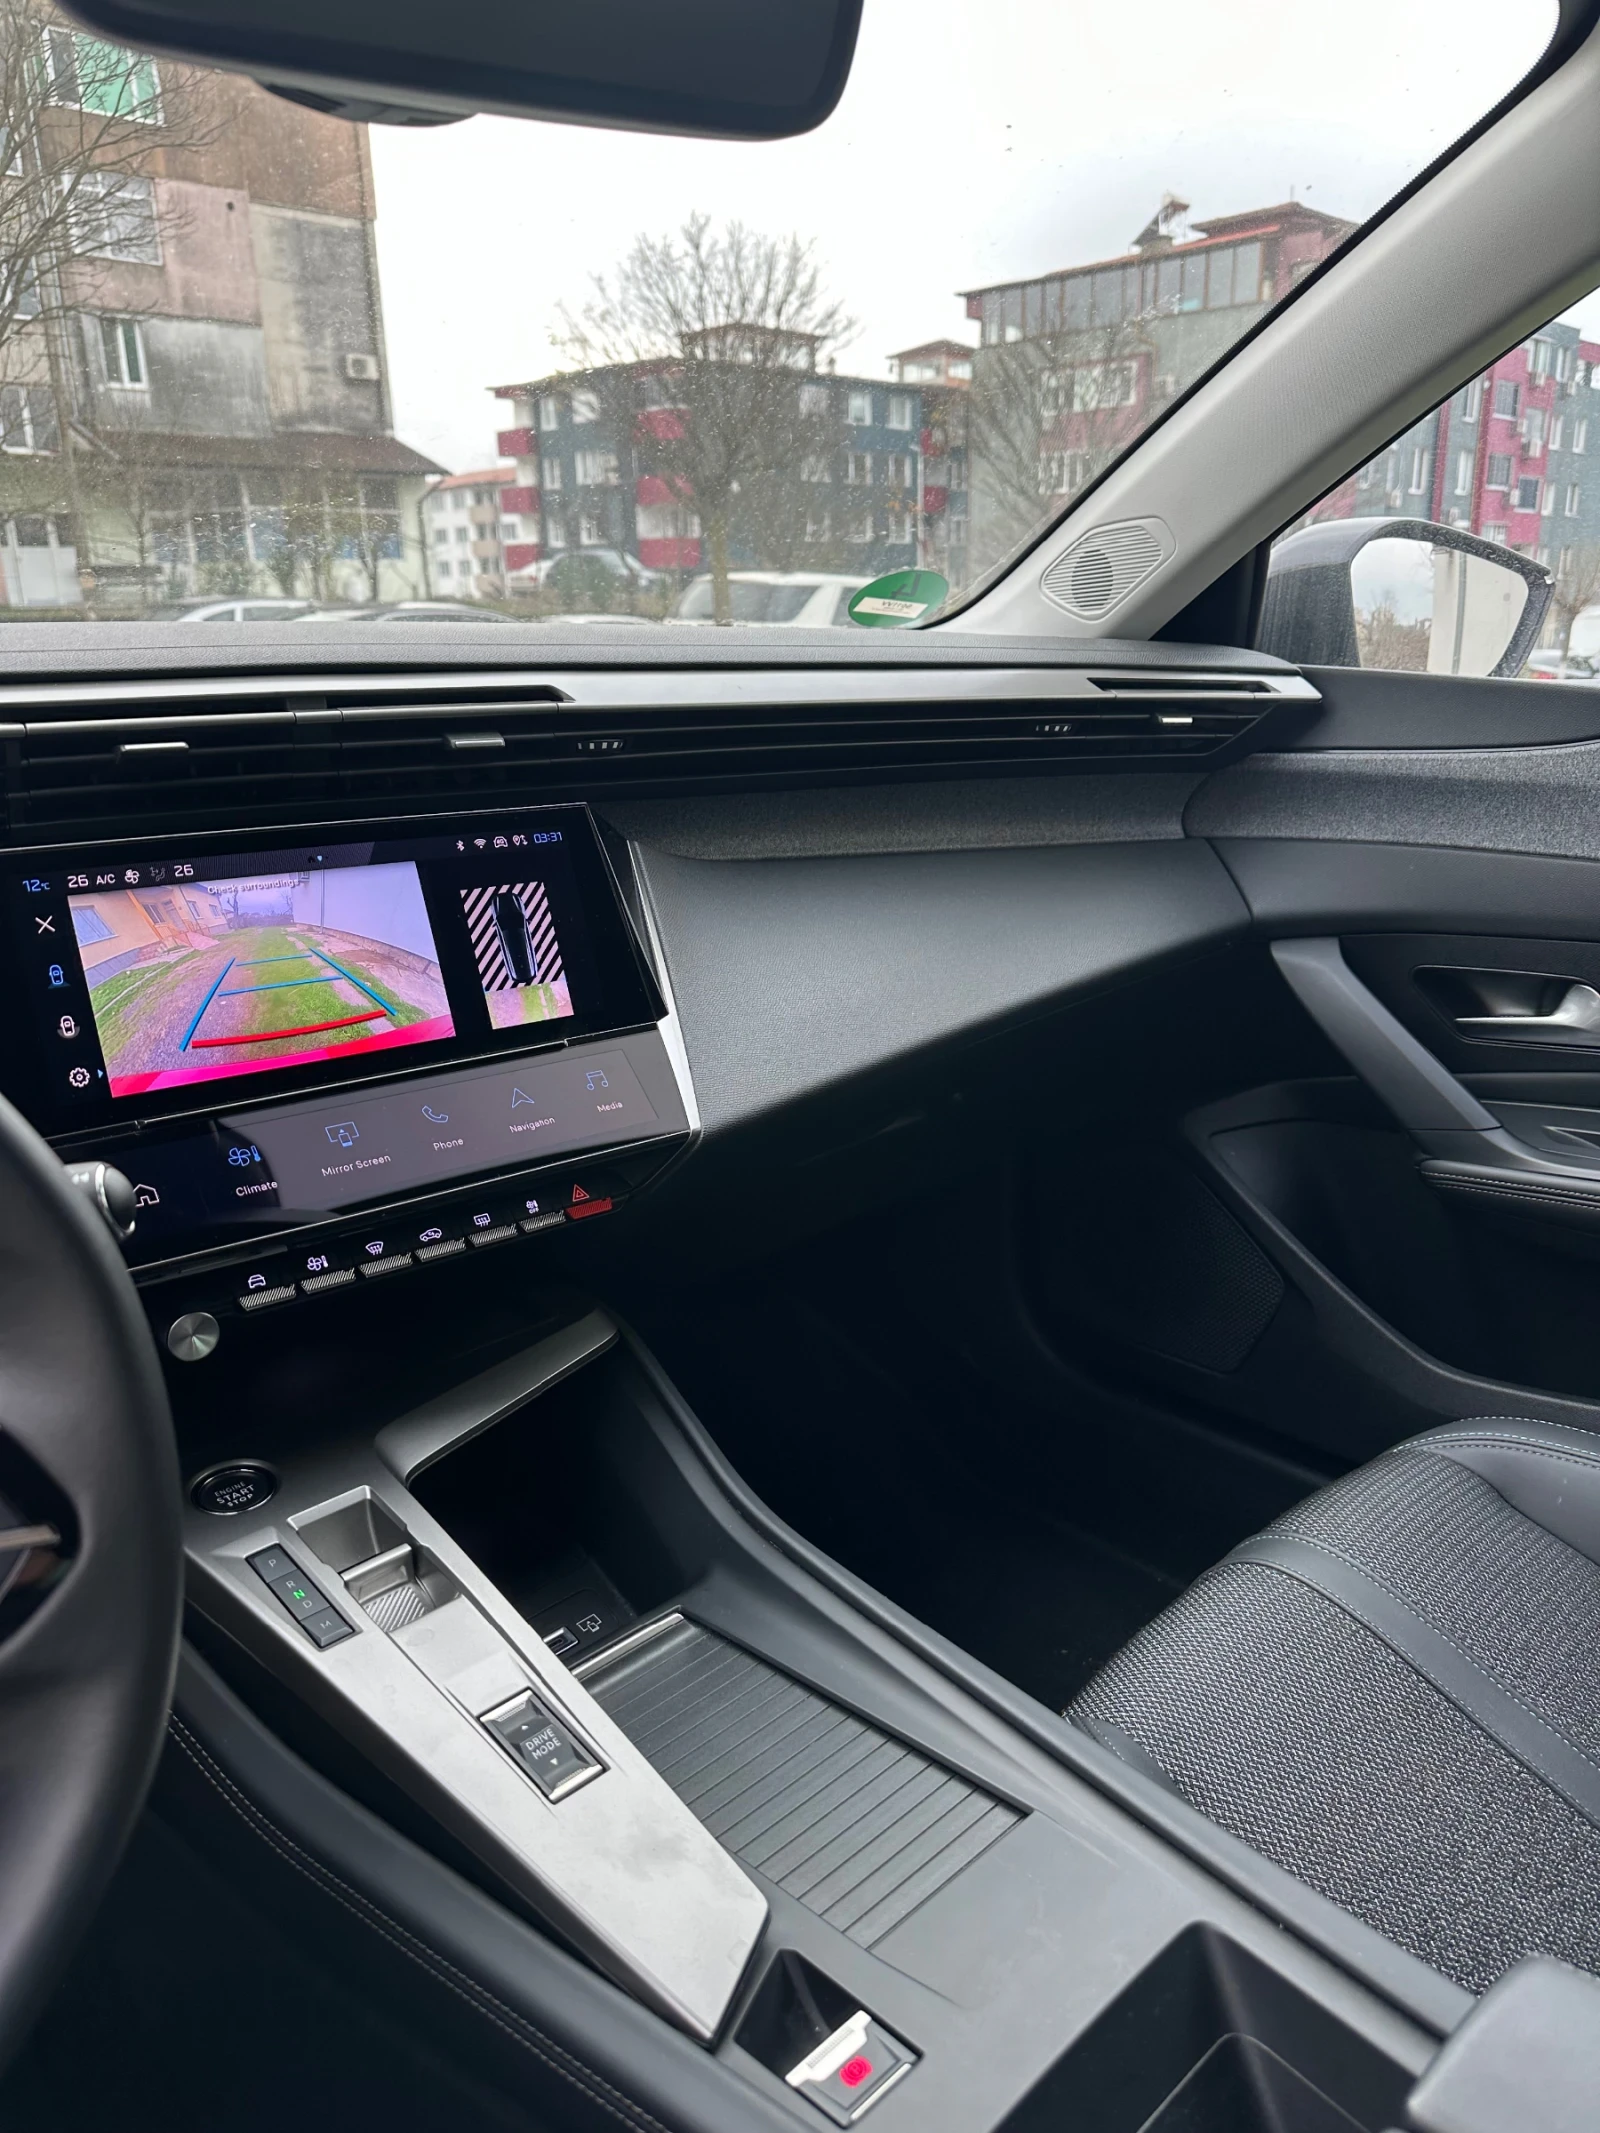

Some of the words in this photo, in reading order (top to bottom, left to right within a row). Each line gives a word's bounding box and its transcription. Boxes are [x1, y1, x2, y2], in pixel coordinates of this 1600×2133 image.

[533, 831, 563, 844] 03:31
[22, 879, 51, 892] 12°C
[67, 874, 89, 889] 26
[95, 873, 116, 886] A/C
[173, 864, 194, 877] 26
[207, 882, 239, 896] Check
[239, 878, 301, 892] surroundings
[596, 1100, 624, 1114] Media
[509, 1115, 556, 1135] Navigation
[433, 1137, 464, 1152] Phone
[321, 1162, 355, 1178] Mirror
[355, 1153, 391, 1169] Screen
[235, 1180, 279, 1197] Climate
[214, 1481, 246, 1497] ENGINE
[216, 1484, 255, 1504] START
[227, 1493, 253, 1507] STOP
[268, 1558, 277, 1568] P
[285, 1580, 296, 1589] R
[293, 1589, 306, 1600] N
[302, 1600, 313, 1609] D
[319, 1620, 333, 1629] M
[525, 1728, 555, 1751] DRIVE
[531, 1737, 562, 1760] MODE
